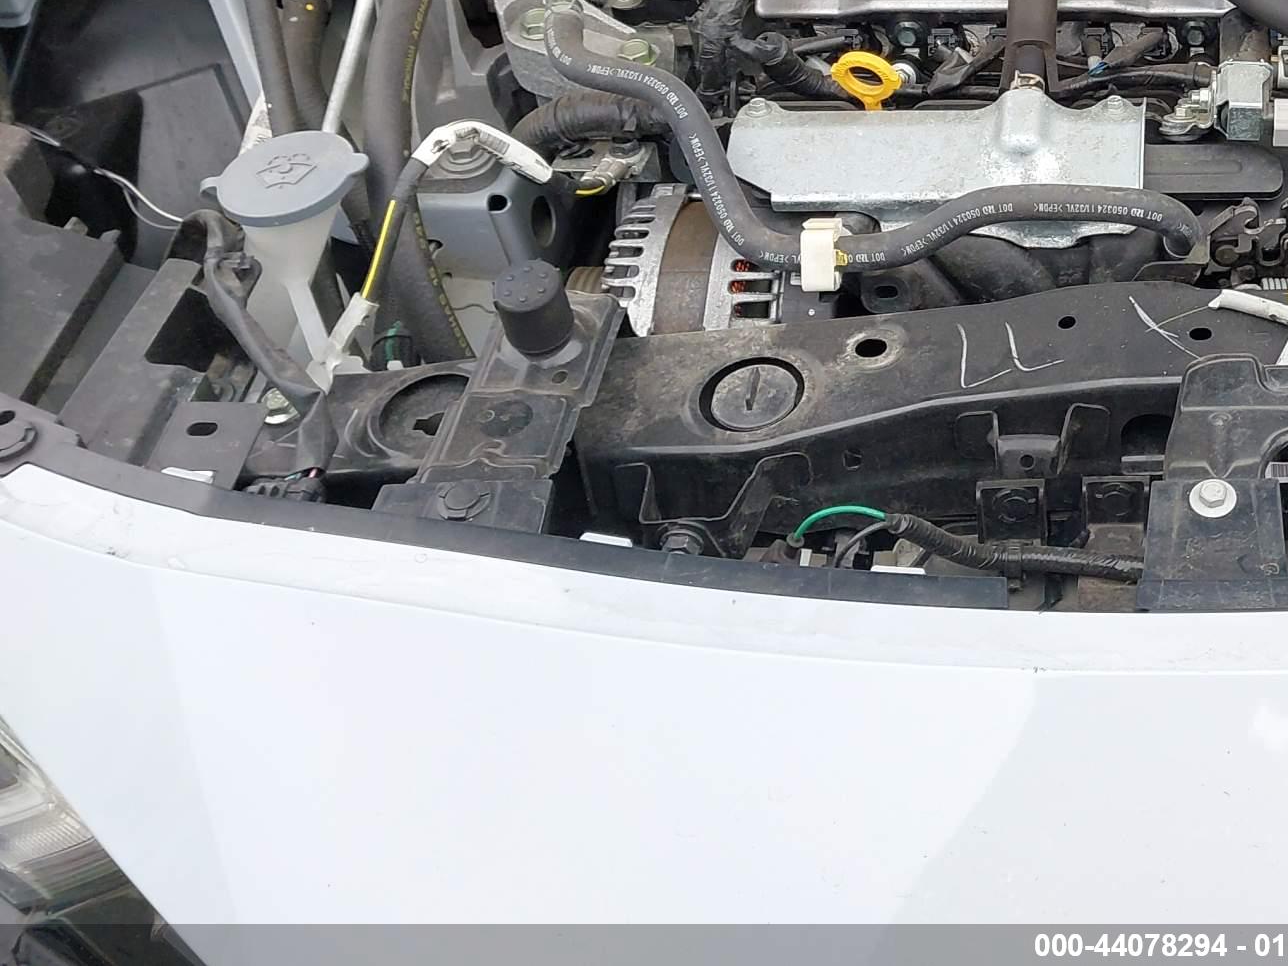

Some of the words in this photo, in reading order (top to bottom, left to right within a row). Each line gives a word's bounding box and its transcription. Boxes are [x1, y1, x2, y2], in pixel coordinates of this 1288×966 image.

[997, 203, 1013, 213] DOT
[1097, 204, 1129, 215] 050324
[952, 208, 981, 224] 050324
[1146, 211, 1164, 222] DOT
[870, 252, 886, 263] DOT
